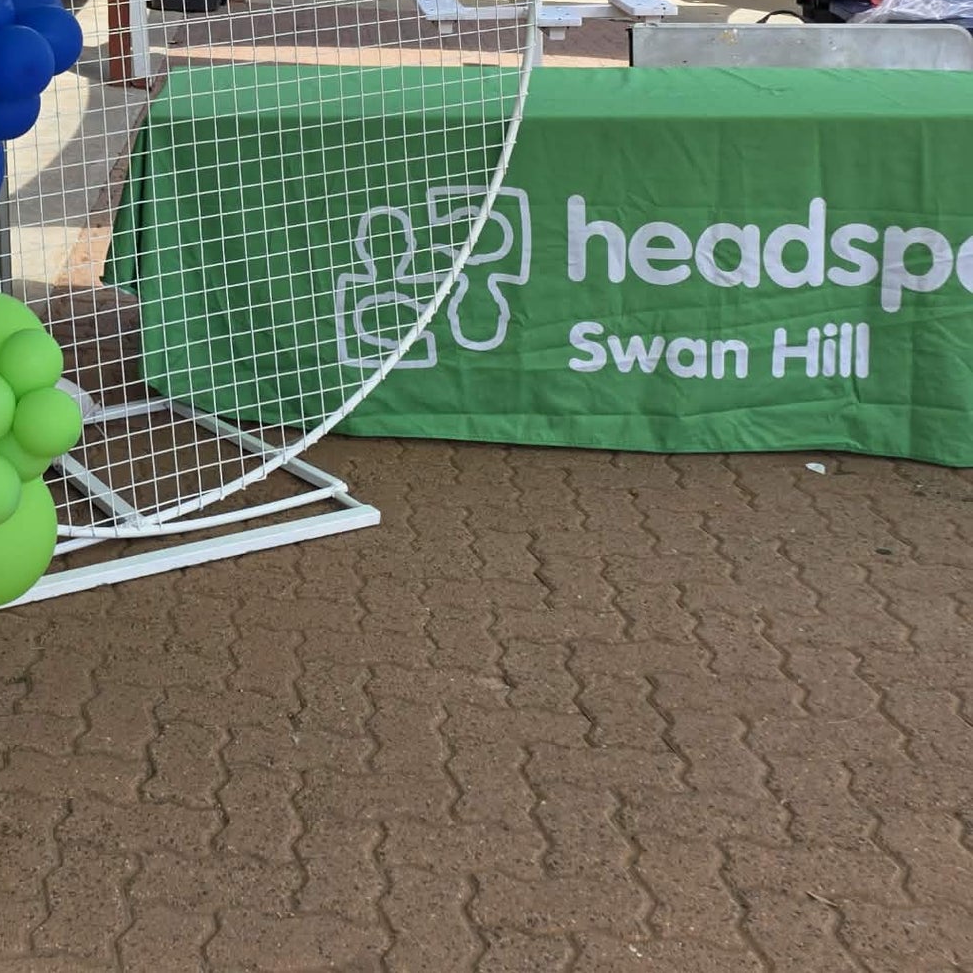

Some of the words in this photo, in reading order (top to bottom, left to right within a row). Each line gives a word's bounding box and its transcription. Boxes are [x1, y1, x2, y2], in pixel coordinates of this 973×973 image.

[567, 195, 973, 314] headsp
[568, 321, 749, 380] Swan
[772, 322, 870, 379] Hill
